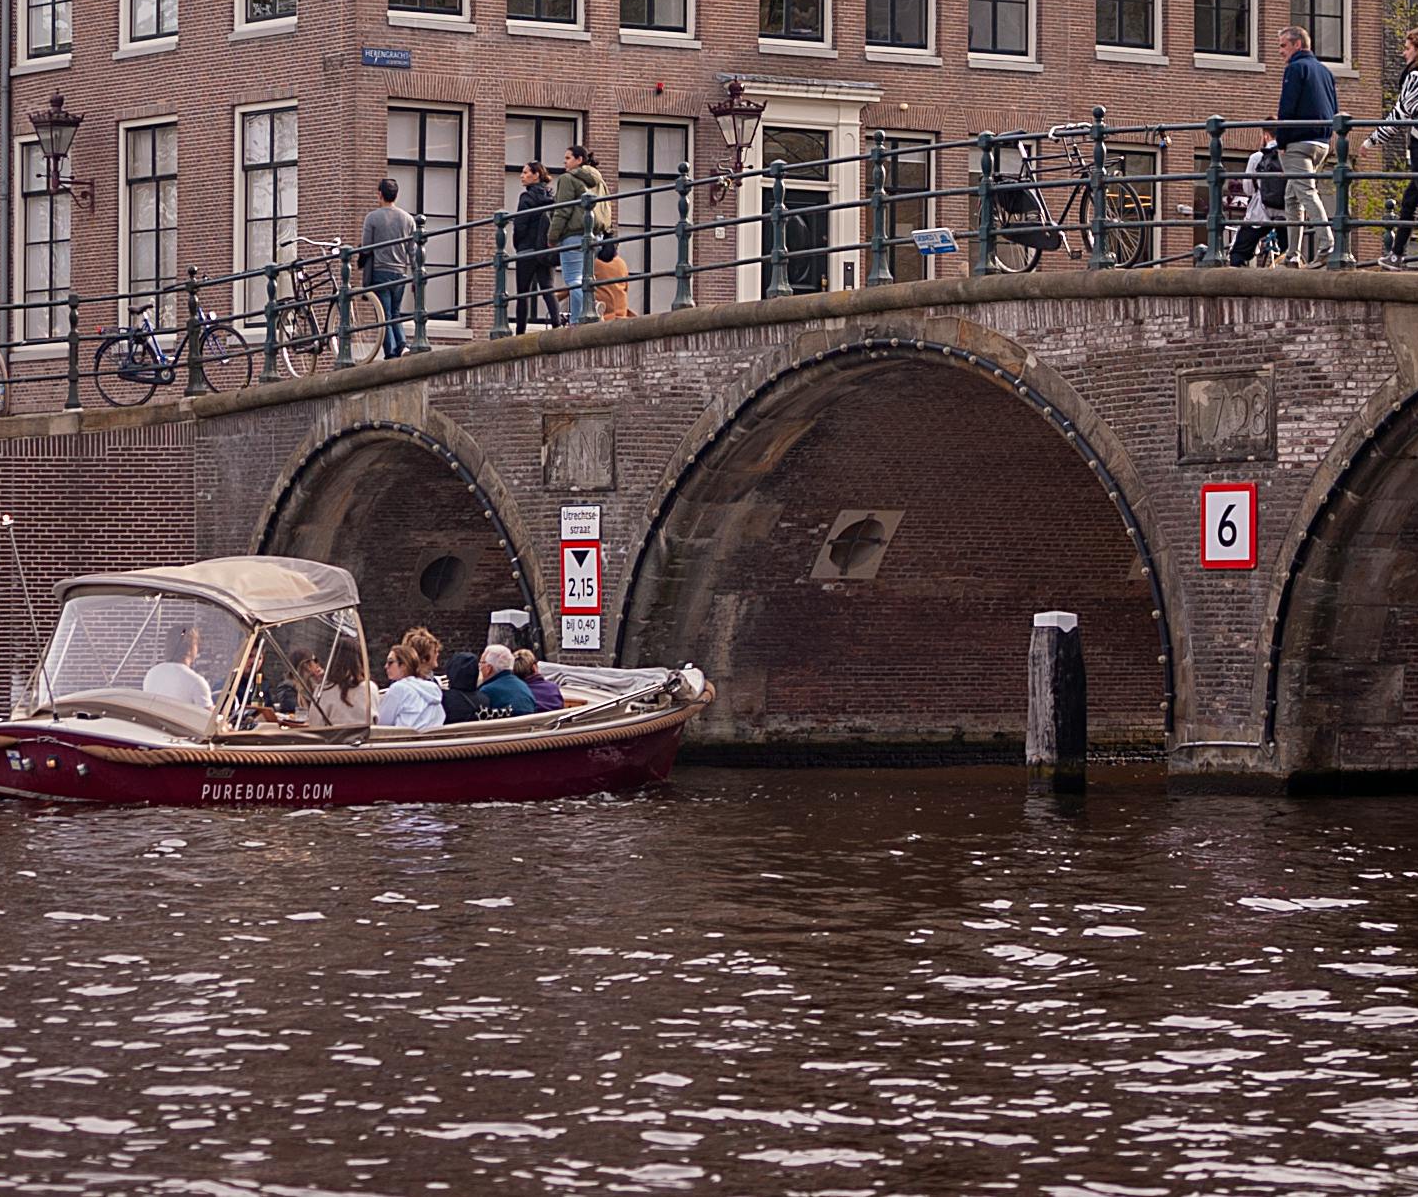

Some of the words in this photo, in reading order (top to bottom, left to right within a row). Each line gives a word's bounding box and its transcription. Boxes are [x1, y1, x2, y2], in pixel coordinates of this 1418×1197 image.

[570, 525, 591, 534] straat
[1217, 504, 1238, 547] 6
[568, 578, 594, 600] 2,15
[566, 619, 576, 632] bij
[577, 619, 596, 631] 0,40
[571, 634, 590, 646] -NAP
[201, 784, 334, 800] PUREBOATS.COM
